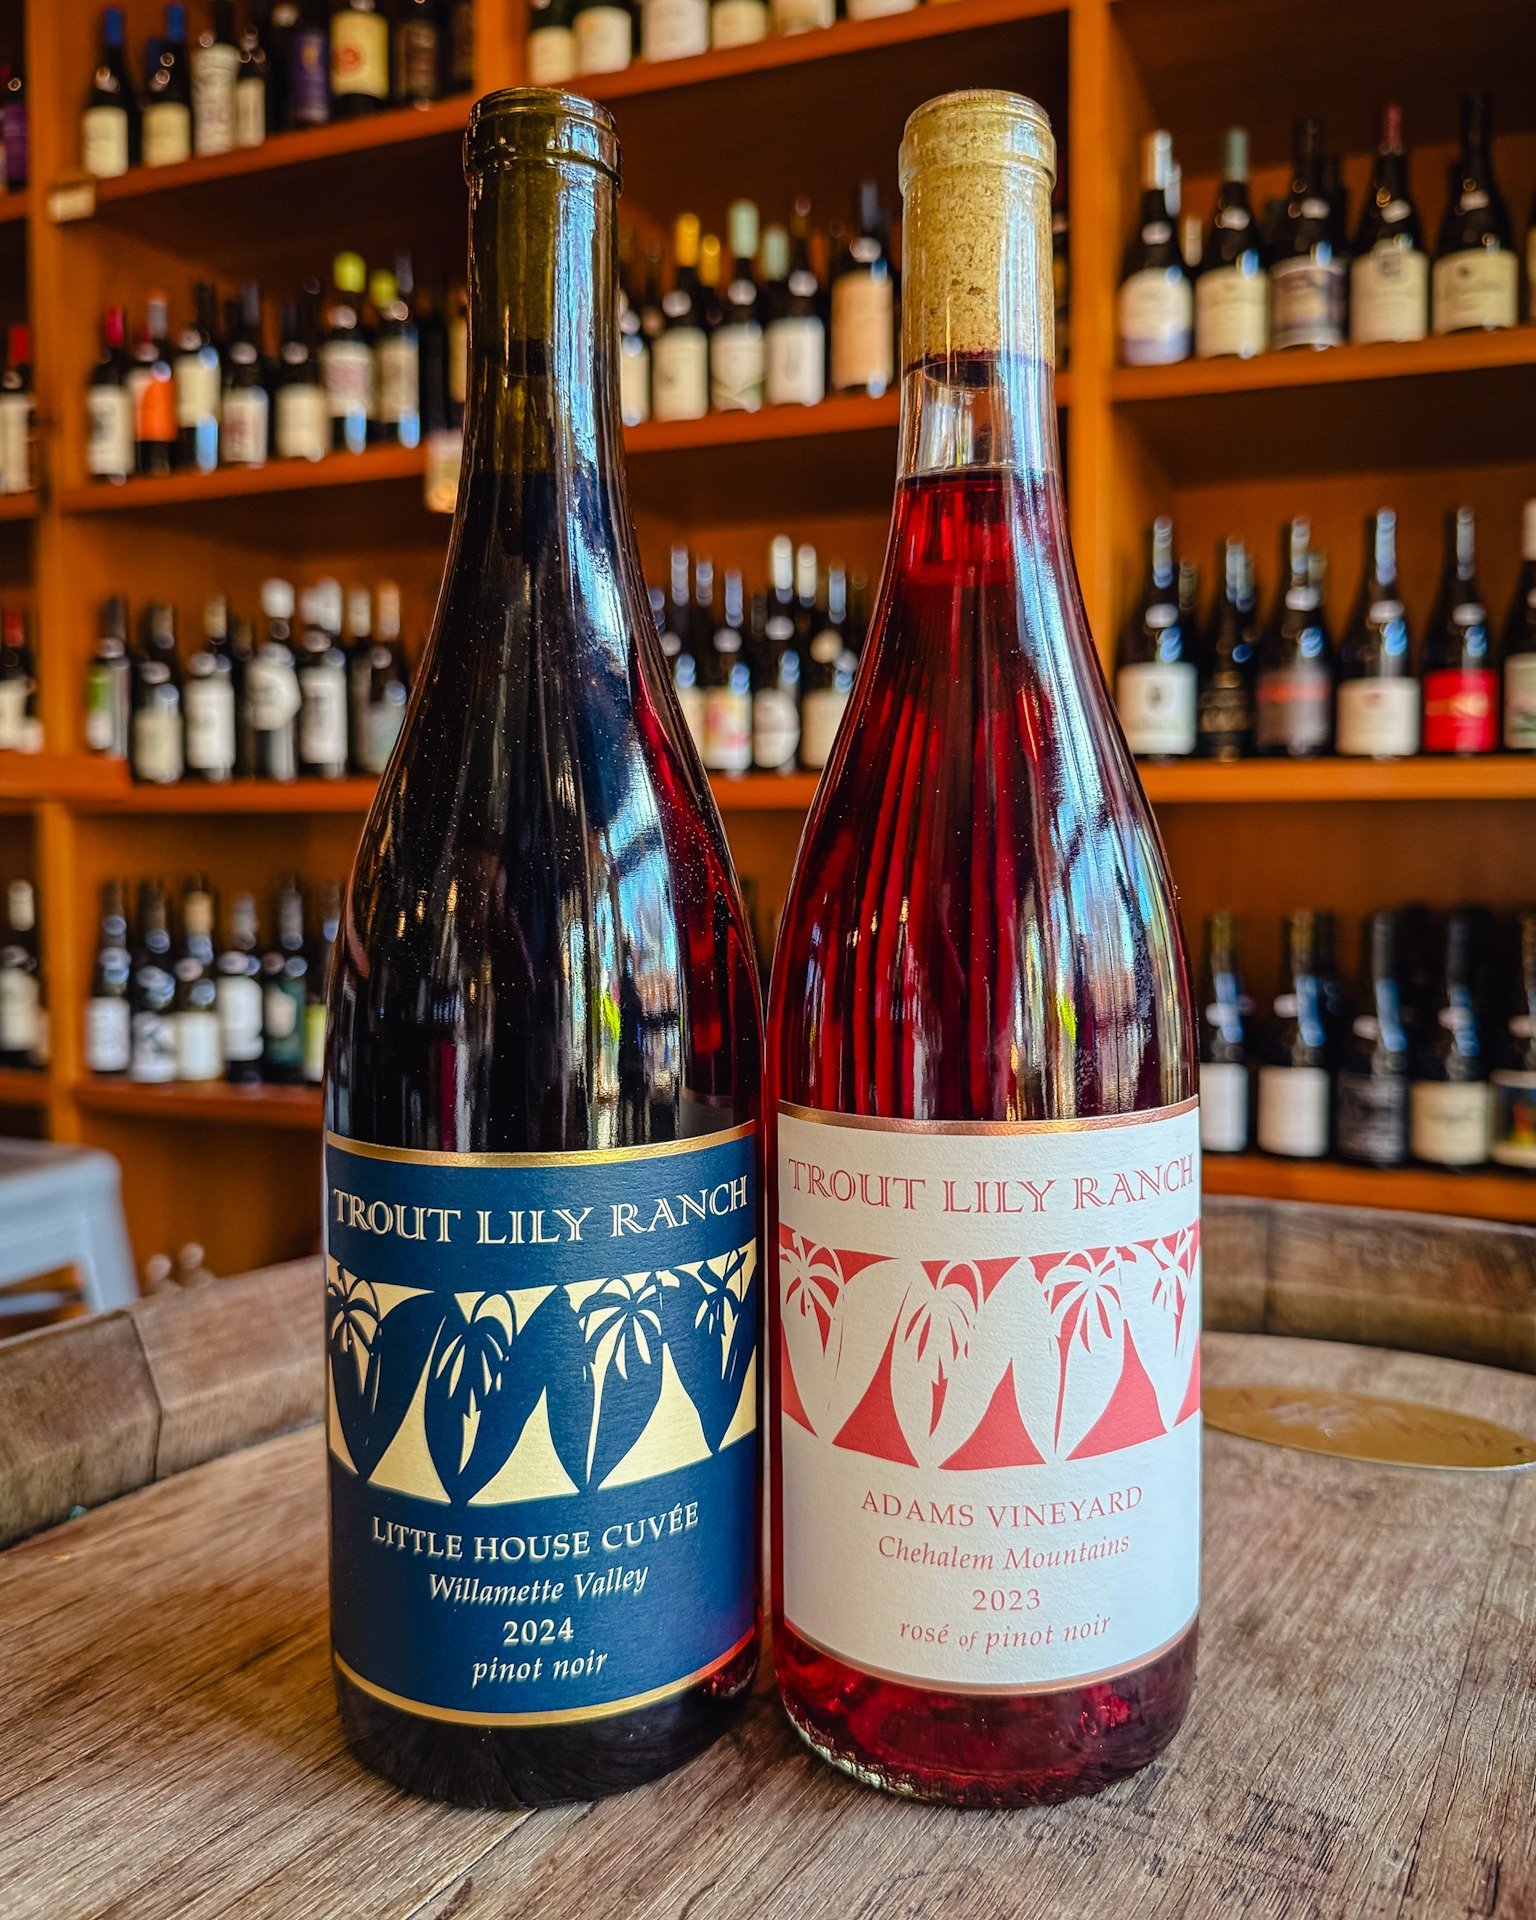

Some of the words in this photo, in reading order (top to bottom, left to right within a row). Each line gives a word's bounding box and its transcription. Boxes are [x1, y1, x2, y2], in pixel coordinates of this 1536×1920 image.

[788, 1157, 926, 1213] TROUT
[943, 1179, 1057, 1214] LILY
[1072, 1152, 1194, 1211] RANCH
[333, 1188, 461, 1245] TROUT
[477, 1206, 596, 1245] LILY
[610, 1174, 748, 1238] RANCH
[861, 1489, 975, 1528] ADAMS
[986, 1485, 1144, 1529] VINEYARD
[372, 1516, 463, 1560] LITTLE
[474, 1531, 590, 1561] HOUSE
[601, 1501, 700, 1550] CUVÉE
[878, 1536, 995, 1571] Chehalem
[1002, 1535, 1131, 1571] Mountains
[429, 1572, 565, 1604] Willamette
[575, 1565, 649, 1599] Valley
[972, 1589, 1041, 1612] 2023
[503, 1617, 575, 1644] 2024
[899, 1621, 949, 1647] rosé
[958, 1630, 977, 1650] of
[985, 1622, 1054, 1655] pinot
[1063, 1614, 1112, 1640] noir
[471, 1657, 543, 1687] pinot
[553, 1649, 608, 1679] noir
